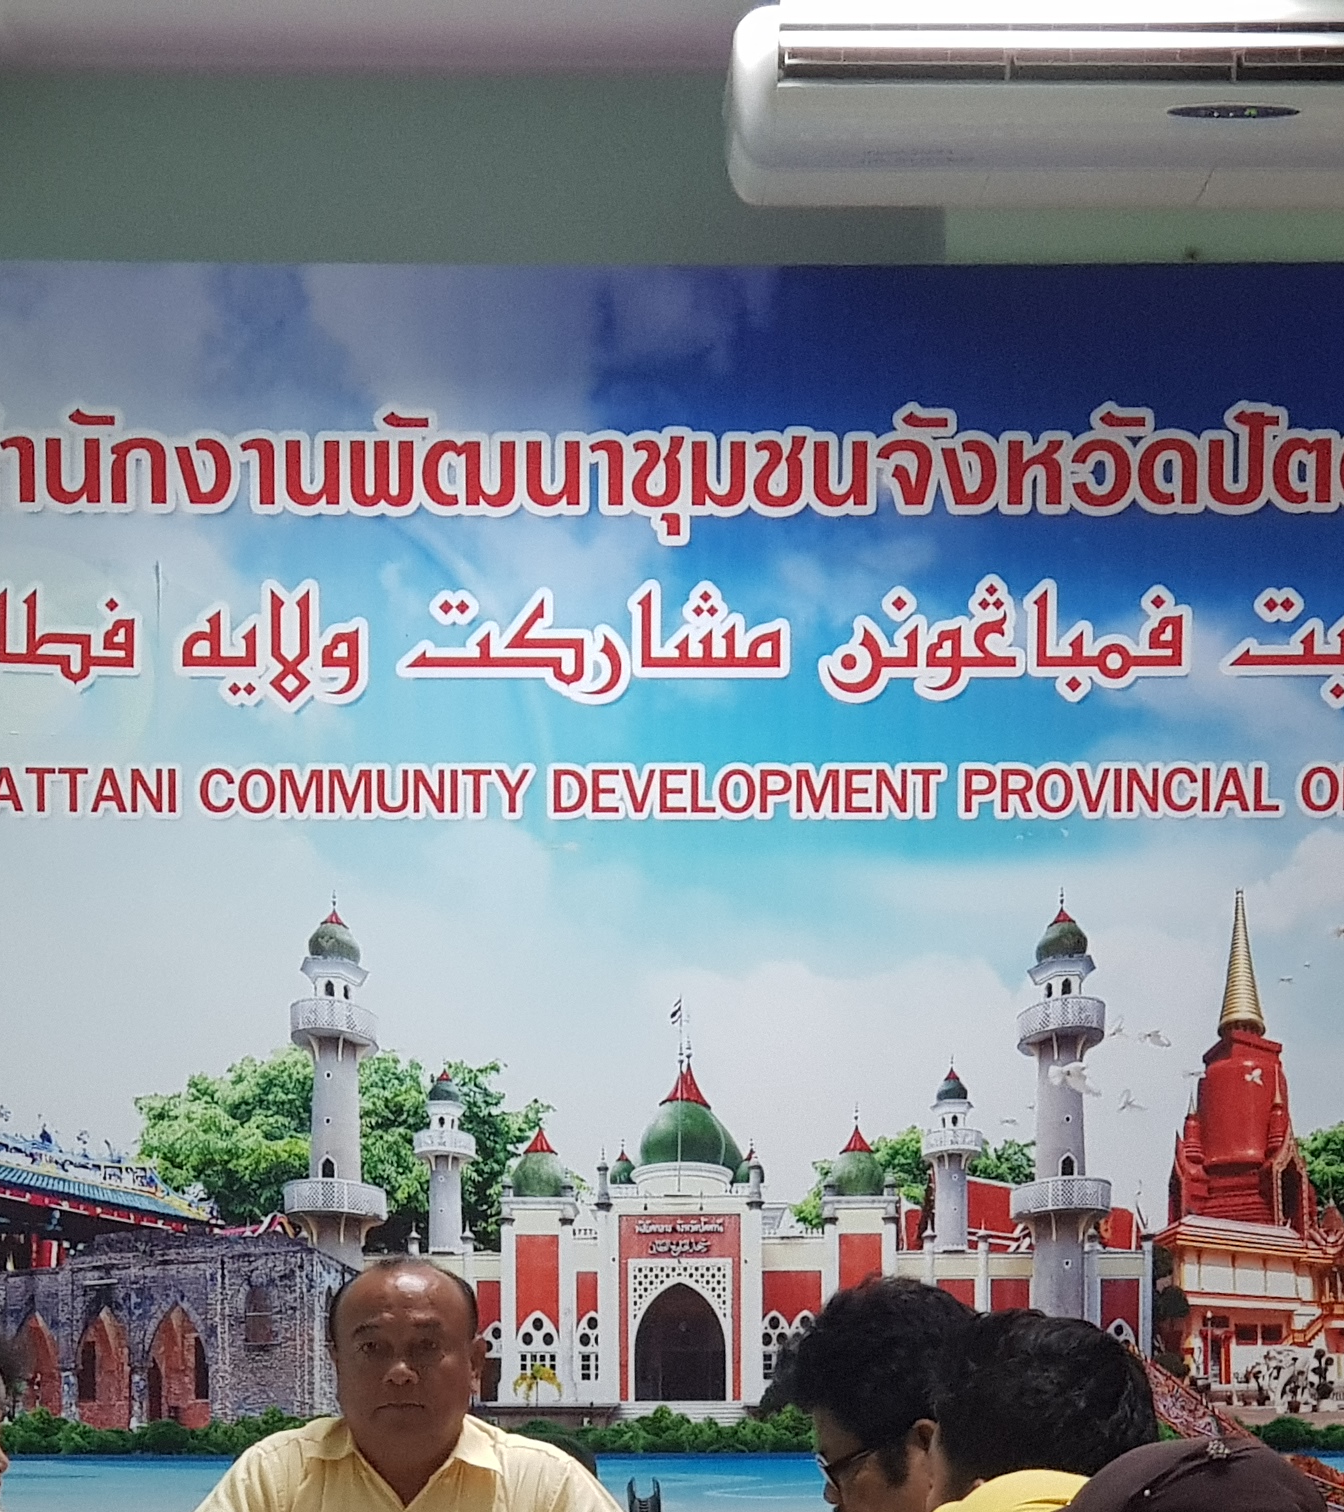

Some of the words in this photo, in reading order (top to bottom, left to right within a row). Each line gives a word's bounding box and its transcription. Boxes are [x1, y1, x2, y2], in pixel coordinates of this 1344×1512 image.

[199, 767, 530, 815] COMMUNITY
[552, 767, 942, 815] DEVELOPMENT
[963, 767, 1281, 814] PROVINCIAL
